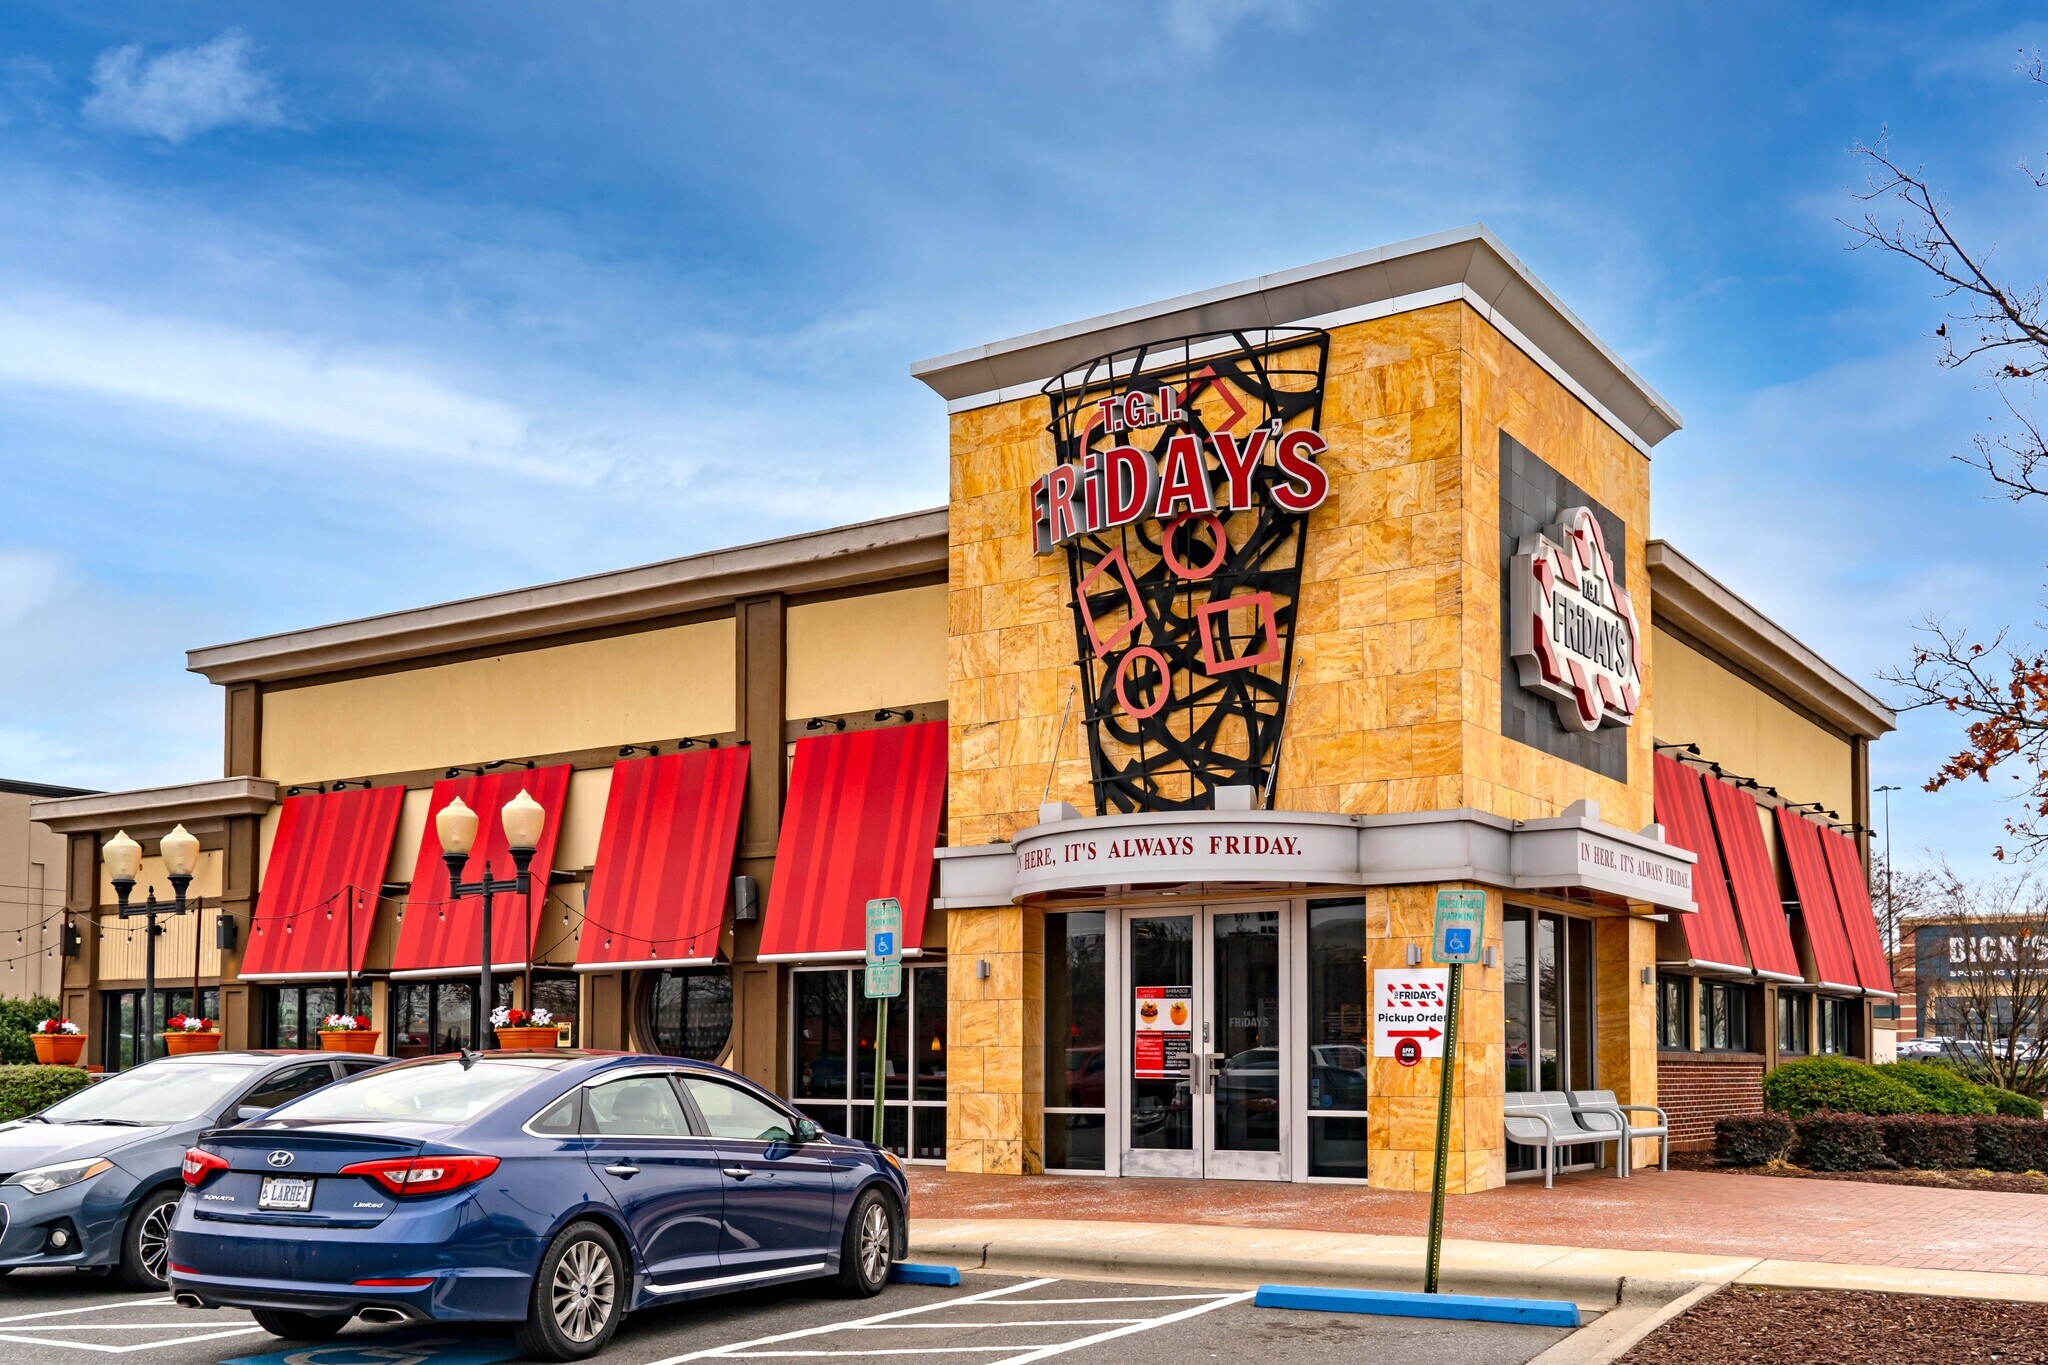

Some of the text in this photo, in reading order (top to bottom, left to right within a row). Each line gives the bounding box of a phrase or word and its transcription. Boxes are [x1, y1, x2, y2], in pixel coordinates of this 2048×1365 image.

[1098, 386, 1187, 434] T.G.I.
[1581, 576, 1600, 606] T.G.I.
[1024, 847, 1056, 870] HERE,
[1064, 841, 1097, 863] IT'S
[1108, 836, 1194, 859] ALWAYS
[1208, 836, 1302, 856] FRIDAY.
[1581, 842, 1690, 889] IN HERE, IT'S ALWAYS FRIDAY.
[1439, 899, 1482, 909] RESERVED
[1441, 912, 1477, 921] PARKING
[1949, 935, 2048, 962] DICK'S
[1399, 990, 1437, 999] FRIDAYS
[1378, 1013, 1415, 1023] Pickup
[203, 1194, 235, 1202] SONATA
